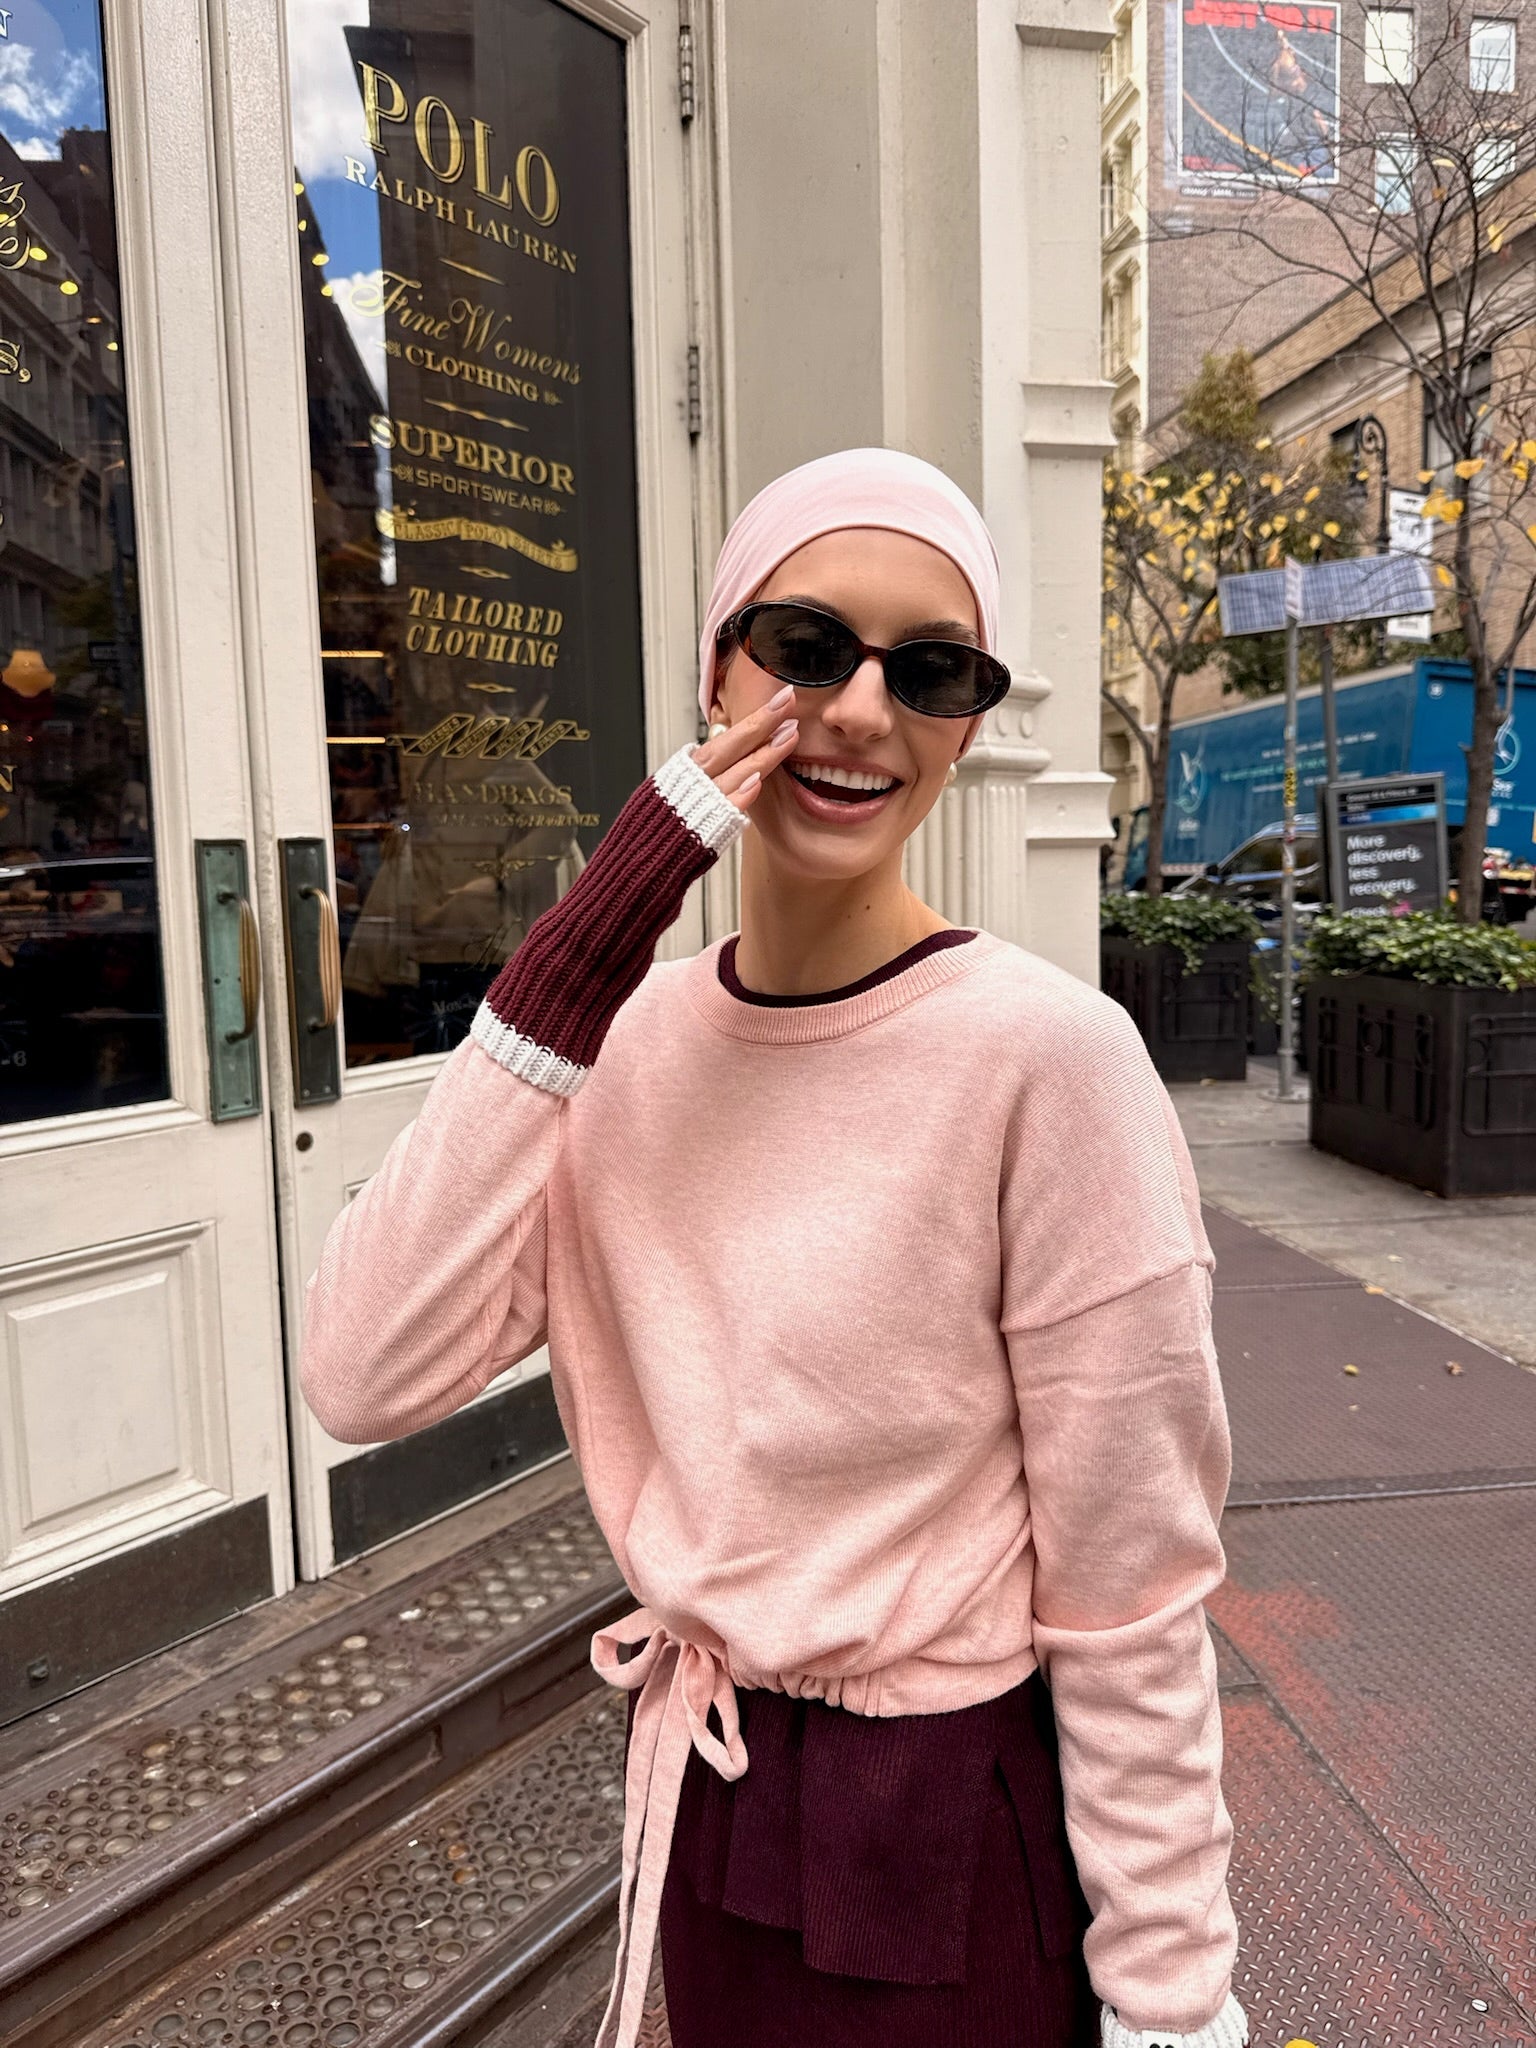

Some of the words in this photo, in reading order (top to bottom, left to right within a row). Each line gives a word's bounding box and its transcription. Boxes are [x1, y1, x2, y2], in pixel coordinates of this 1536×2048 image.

[357, 60, 560, 227] POLO
[343, 155, 457, 224] RALPH
[464, 208, 578, 274] LAUREN
[350, 270, 451, 341] Fine
[405, 344, 540, 402] CLOTHING
[369, 414, 576, 494] SUPERIOR
[416, 468, 545, 512] SPORTSWEAR
[394, 519, 456, 540] CLASSIC
[465, 522, 502, 543] POLO
[408, 586, 564, 637] TAILORED
[405, 623, 560, 668] CLOTHING
[1347, 834, 1386, 850] More
